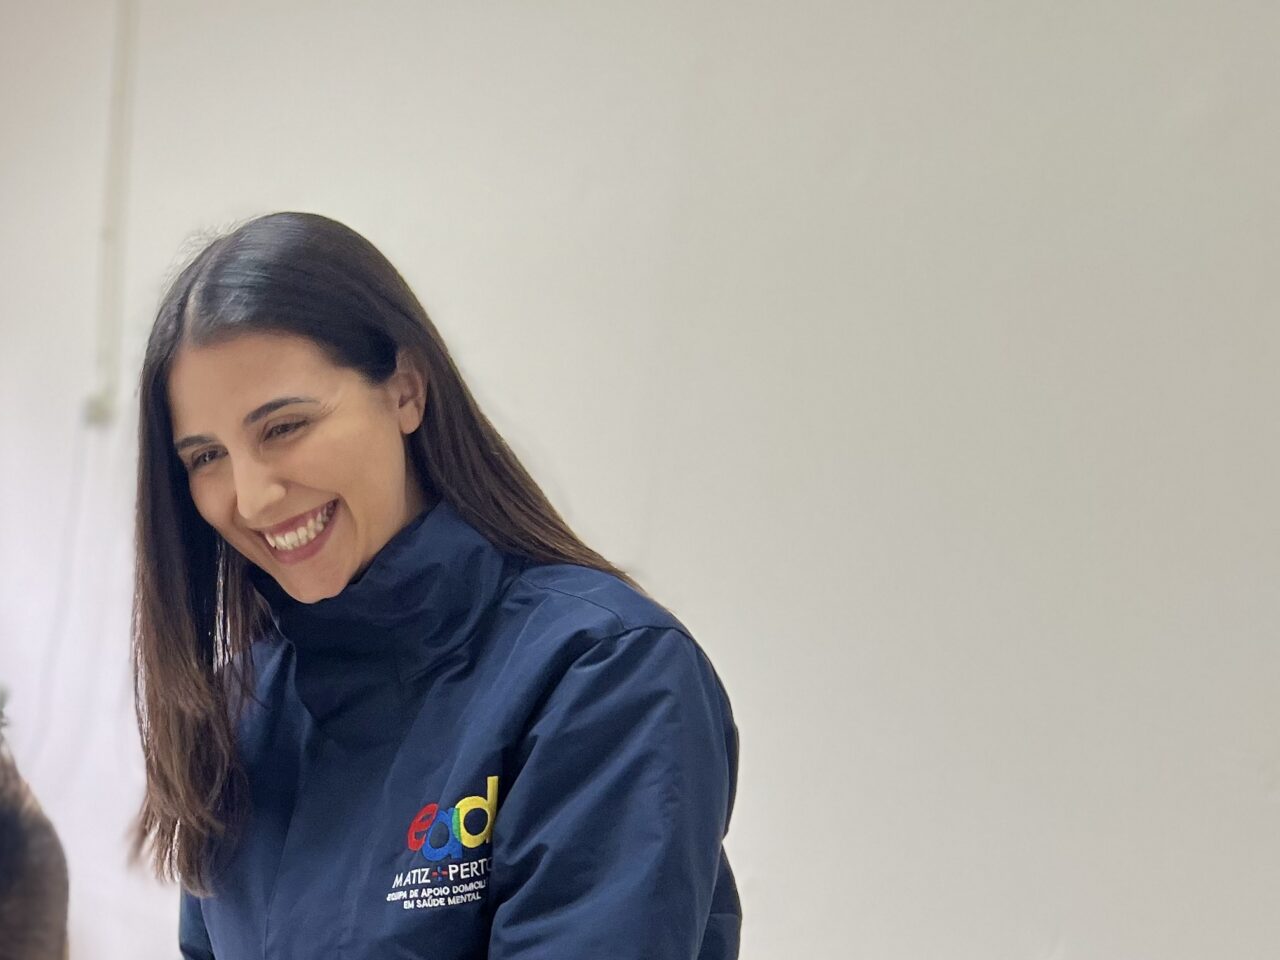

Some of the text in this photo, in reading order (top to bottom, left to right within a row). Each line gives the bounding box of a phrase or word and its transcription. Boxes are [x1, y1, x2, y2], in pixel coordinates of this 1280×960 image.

[408, 776, 498, 860] ead
[392, 868, 431, 889] MATIZ
[409, 889, 419, 898] DE
[421, 886, 450, 898] APOIO
[453, 880, 486, 893] DOMICILI
[403, 891, 481, 910] EM SAÚDE MENTAL
